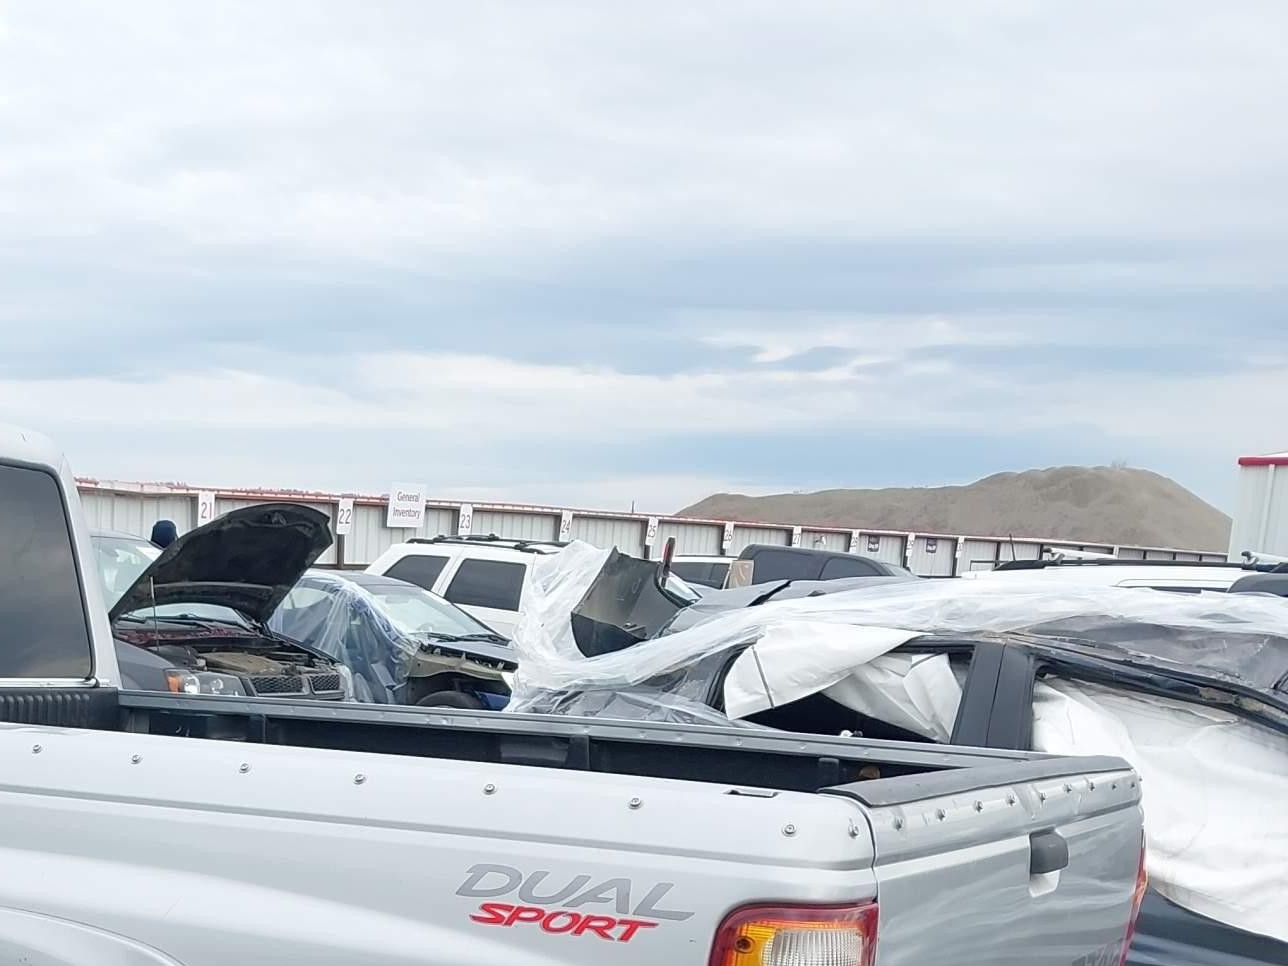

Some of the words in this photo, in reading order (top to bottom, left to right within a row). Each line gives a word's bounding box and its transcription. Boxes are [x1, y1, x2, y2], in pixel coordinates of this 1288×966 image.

[397, 491, 420, 502] General
[201, 502, 212, 520] 21
[339, 508, 351, 524] 22
[393, 507, 421, 519] Inventory
[460, 514, 471, 528] 23
[561, 519, 571, 533] 24
[648, 524, 657, 537] 25
[455, 863, 696, 921] DUAL
[469, 902, 660, 943] SPORT
